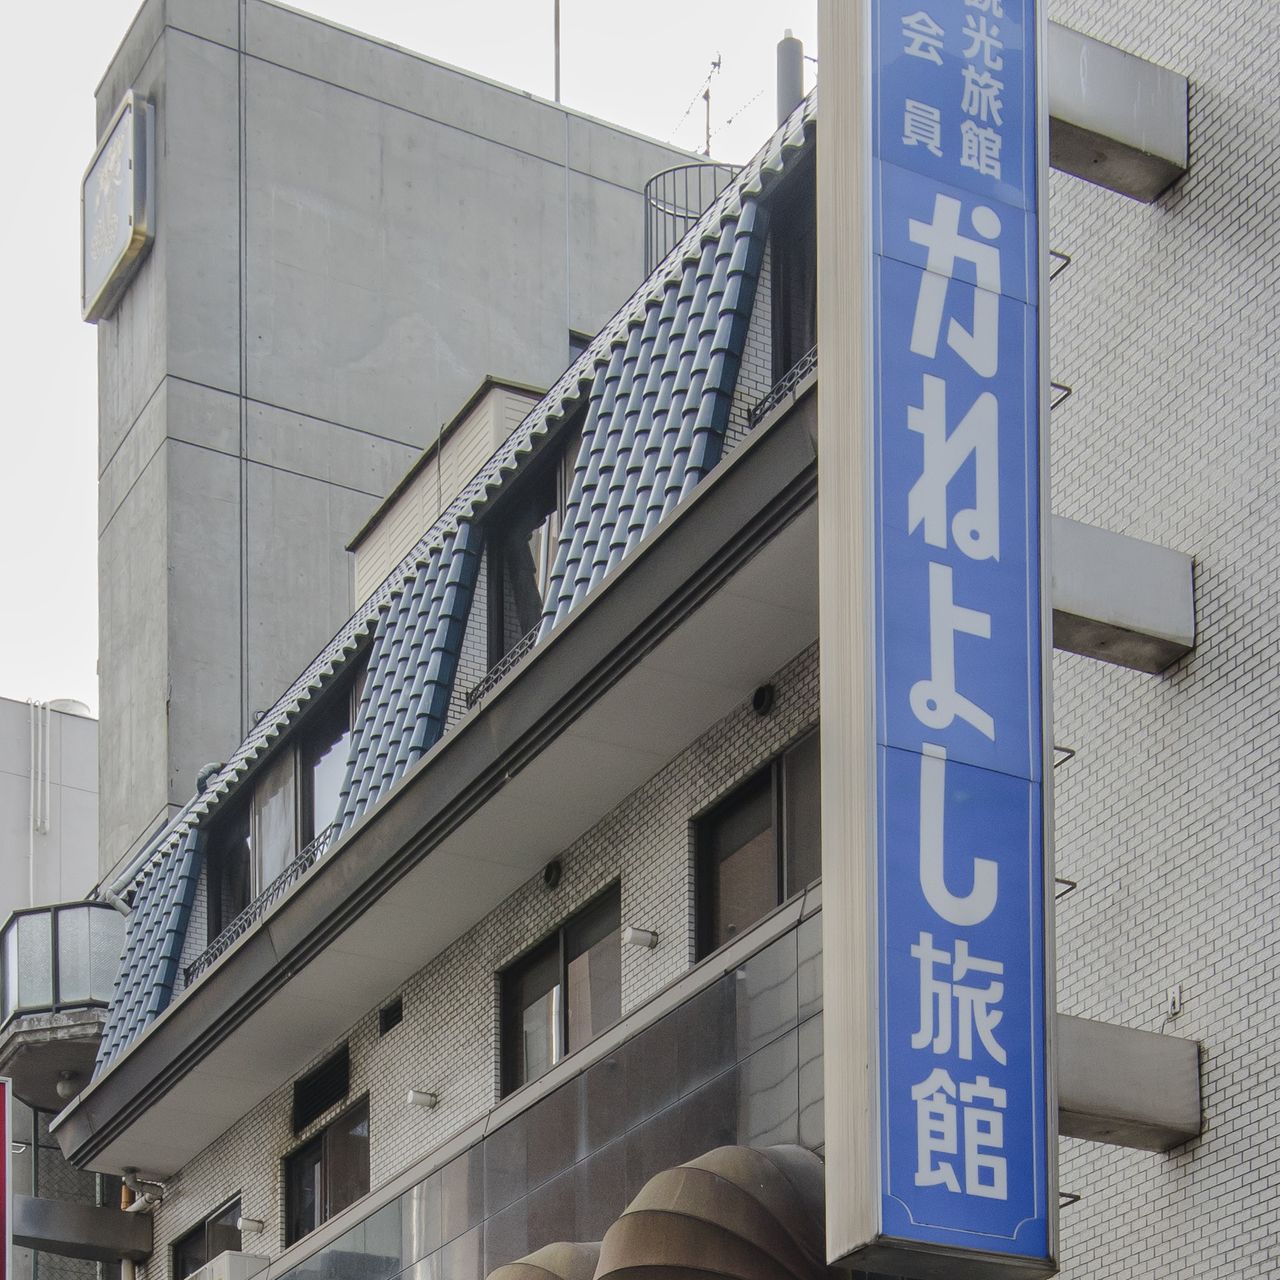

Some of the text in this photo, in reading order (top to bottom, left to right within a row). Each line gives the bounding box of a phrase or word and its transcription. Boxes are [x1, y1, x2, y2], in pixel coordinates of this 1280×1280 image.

[901, 10, 944, 158] 会員
[907, 192, 1008, 1201] かねよし旅館
